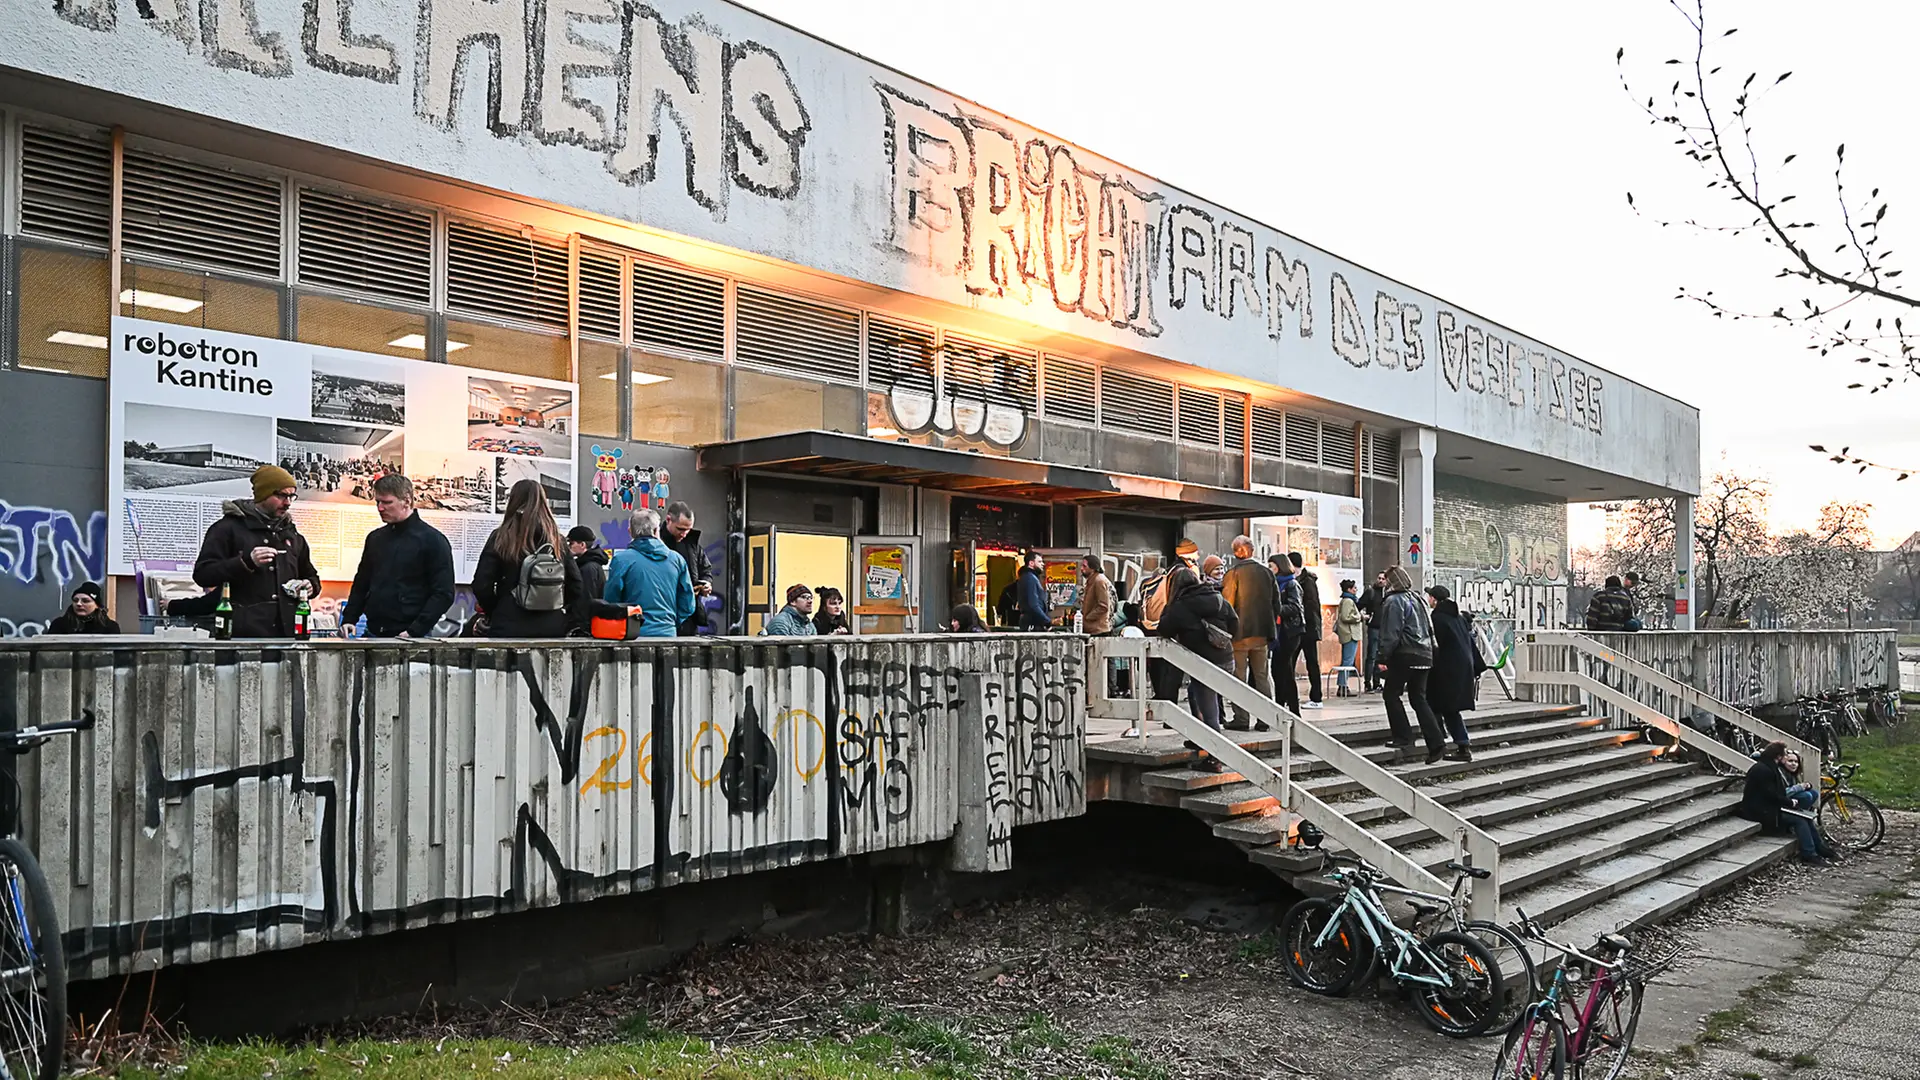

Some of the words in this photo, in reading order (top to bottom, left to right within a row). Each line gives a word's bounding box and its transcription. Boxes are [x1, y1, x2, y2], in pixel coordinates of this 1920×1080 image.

[1167, 203, 1313, 342] ARM
[1331, 271, 1426, 372] DES
[124, 332, 258, 368] robotron
[157, 359, 273, 396] Kantine
